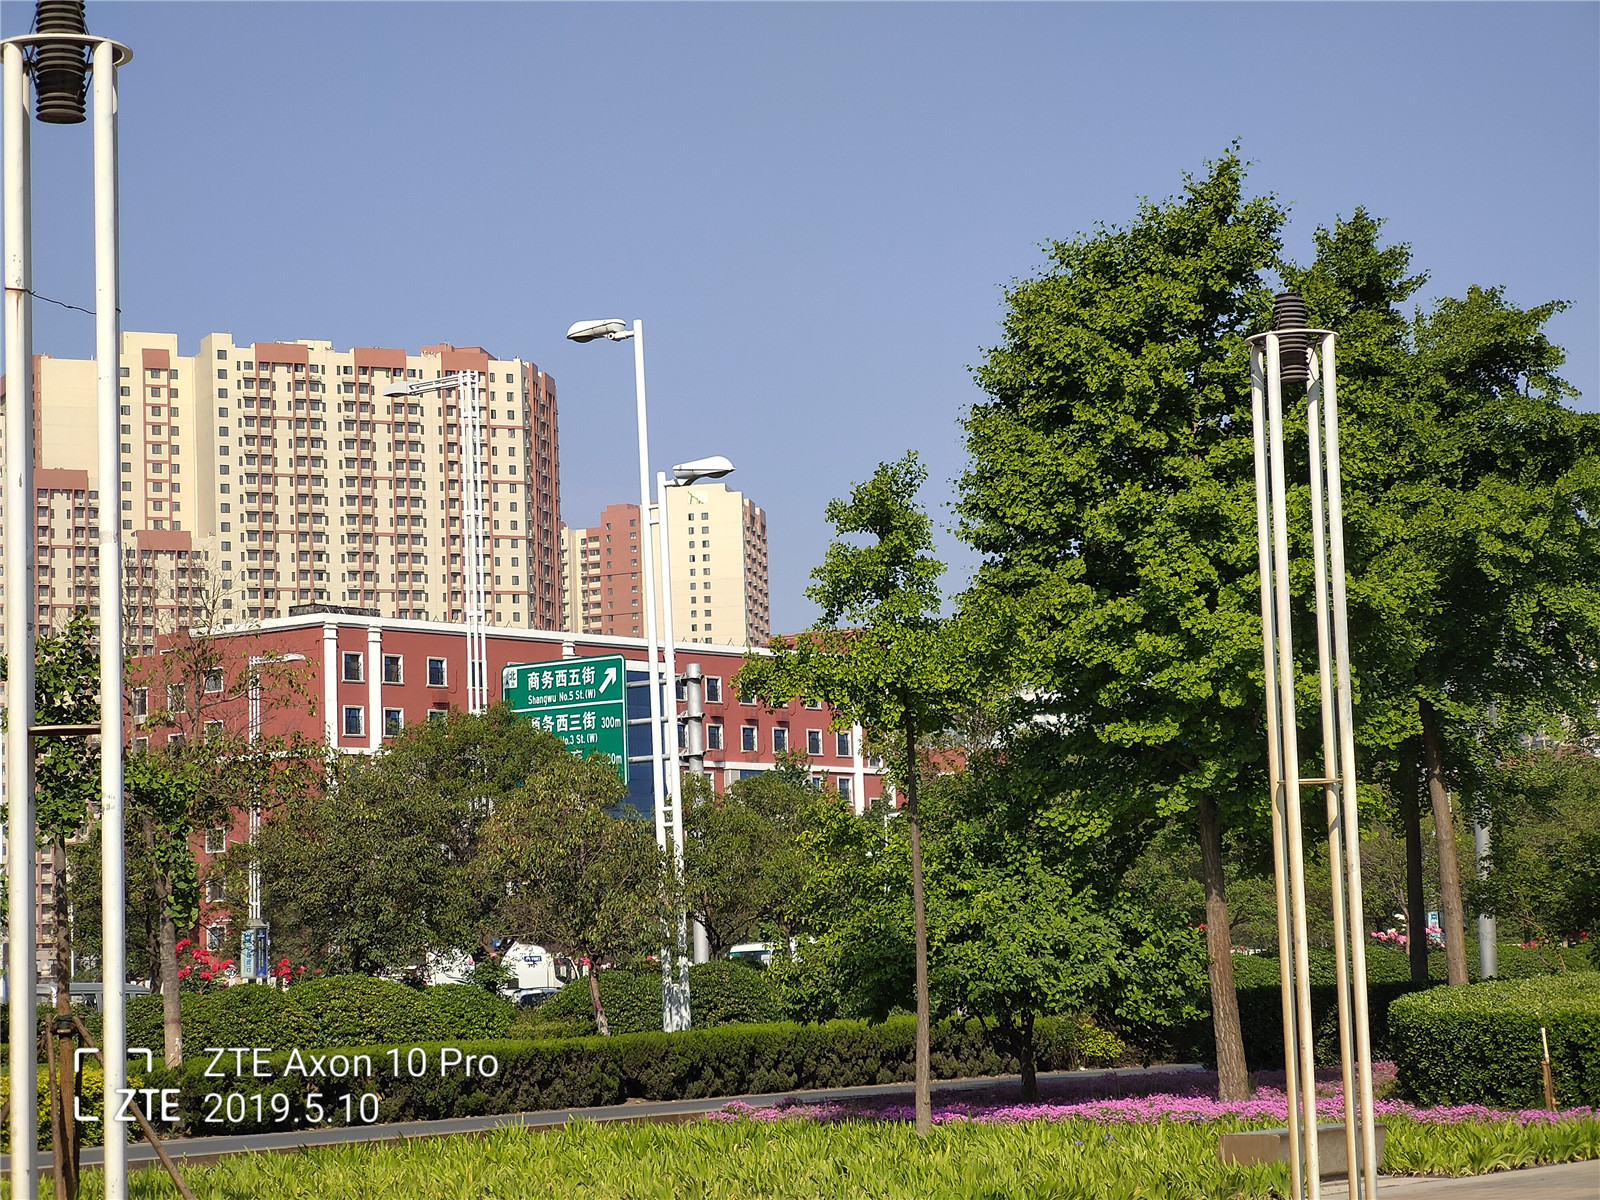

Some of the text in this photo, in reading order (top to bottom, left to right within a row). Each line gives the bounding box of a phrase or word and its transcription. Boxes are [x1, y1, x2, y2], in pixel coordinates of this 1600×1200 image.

[509, 670, 516, 681] 北
[527, 666, 595, 691] 商务西五街
[528, 694, 557, 706] Shangwu
[559, 691, 574, 702] No.5
[601, 716, 622, 728] 300m
